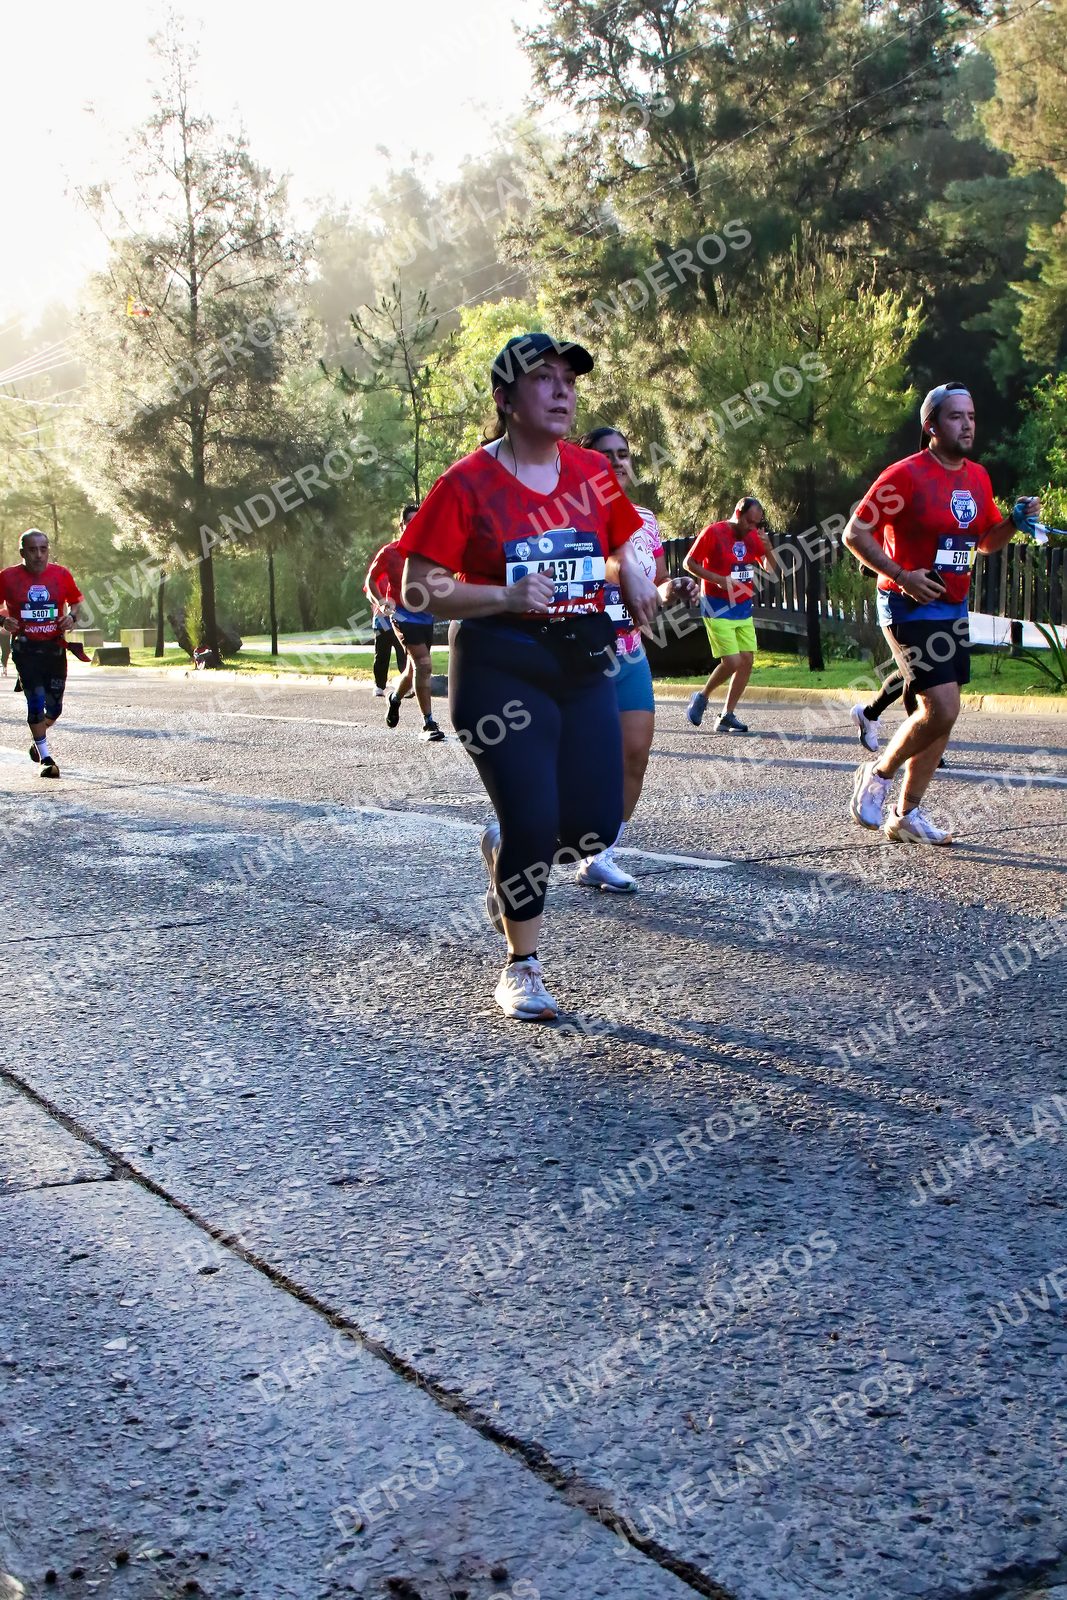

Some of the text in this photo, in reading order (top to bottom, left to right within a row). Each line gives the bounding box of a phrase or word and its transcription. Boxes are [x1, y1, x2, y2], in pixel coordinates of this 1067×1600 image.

[952, 552, 968, 564] 5719
[537, 560, 577, 582] 4437
[32, 610, 49, 618] 5407
